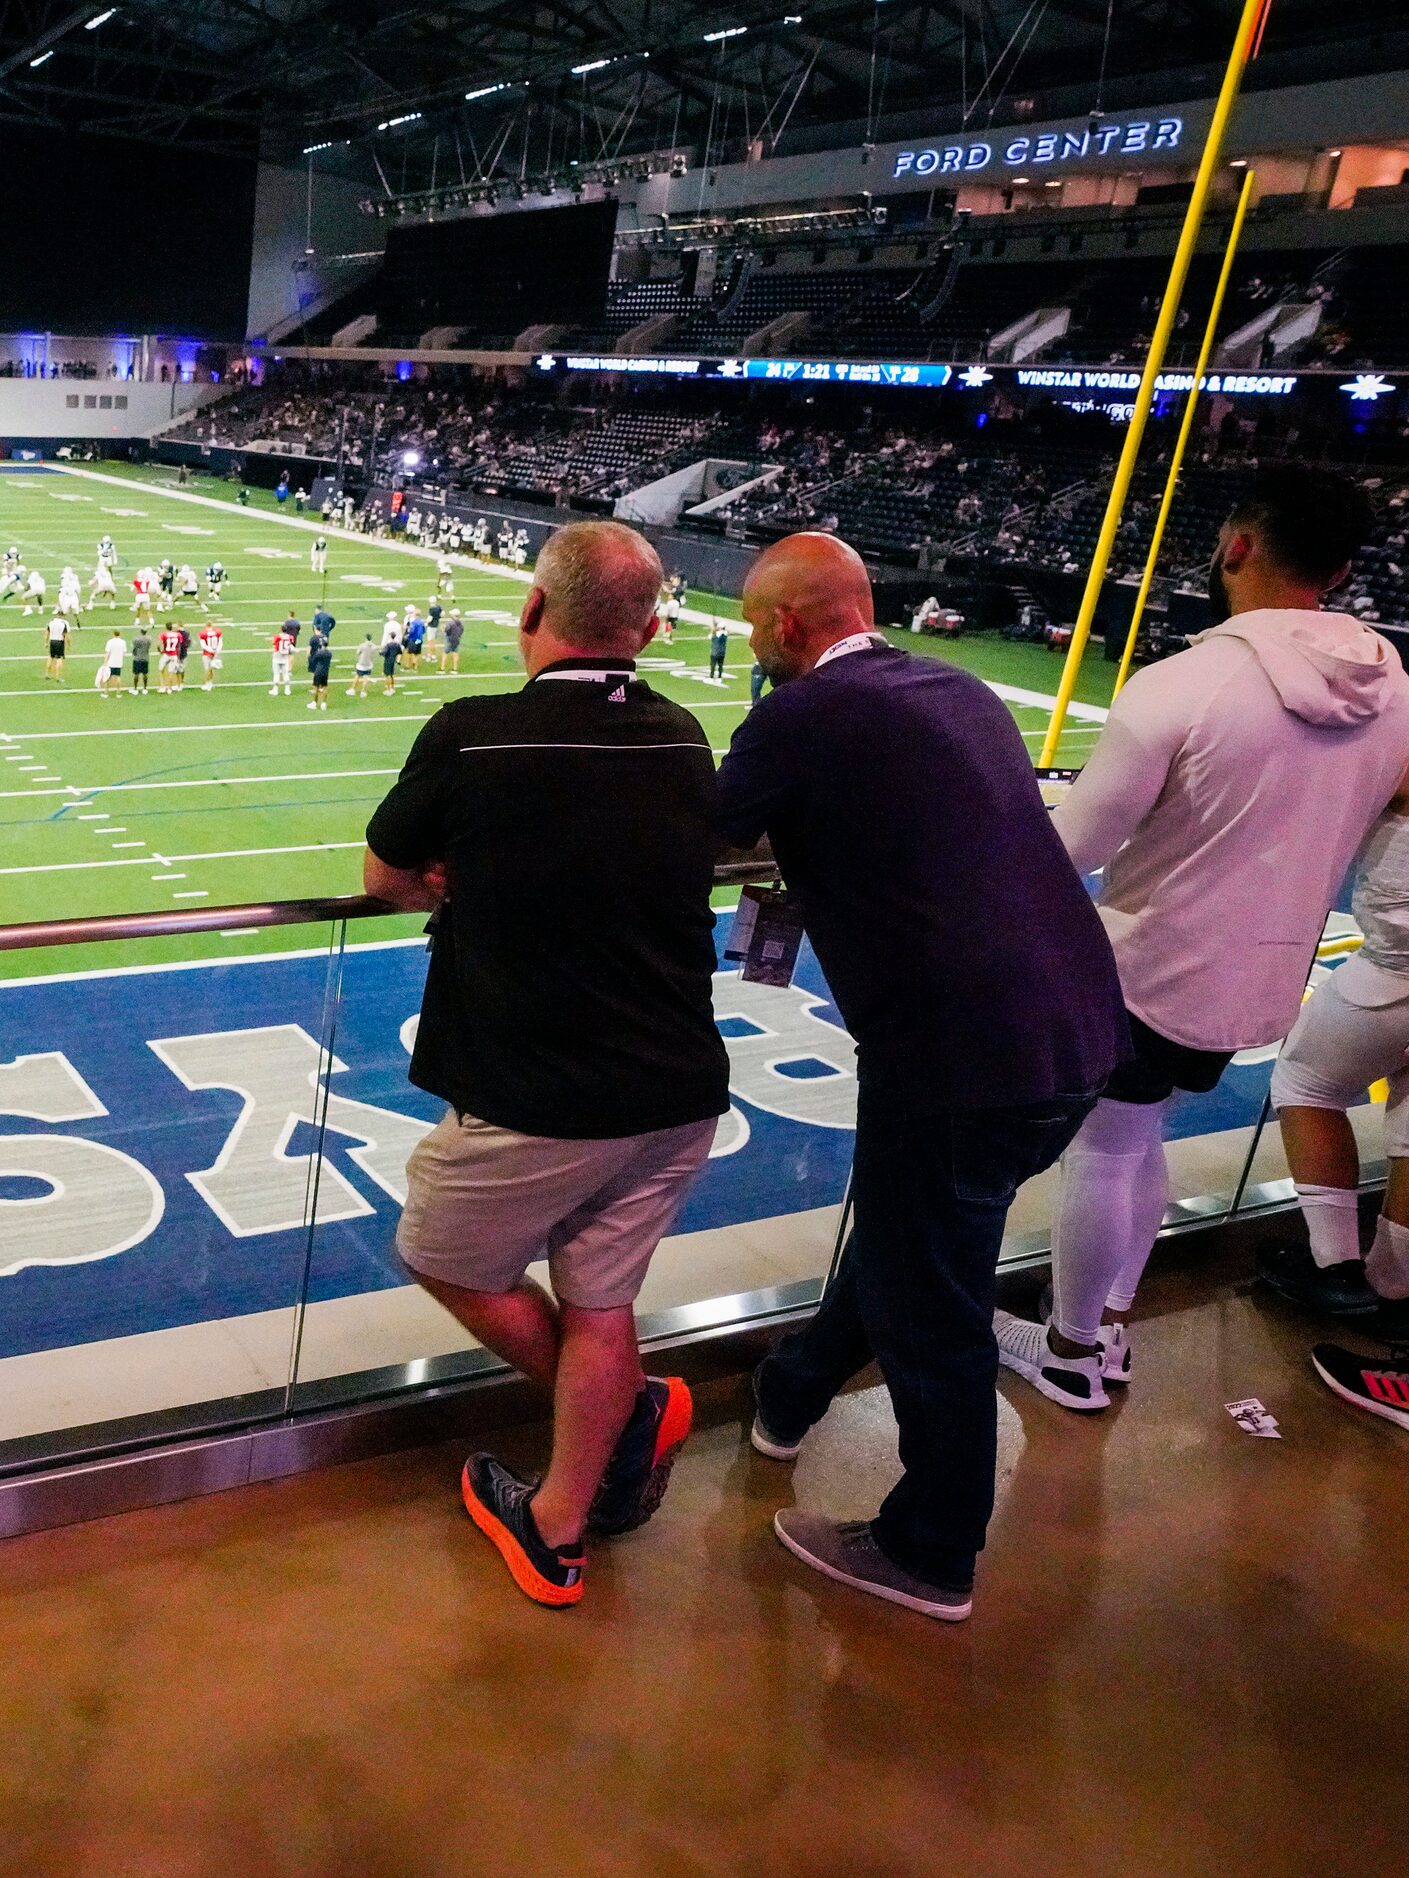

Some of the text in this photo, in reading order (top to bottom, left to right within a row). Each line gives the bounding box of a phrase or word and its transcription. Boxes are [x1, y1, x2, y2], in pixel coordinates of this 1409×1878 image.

[893, 117, 1183, 178] FORD CENTER
[803, 363, 830, 379] 1:21
[1018, 371, 1297, 393] WINSTAR WORLD ASINO & RESORT
